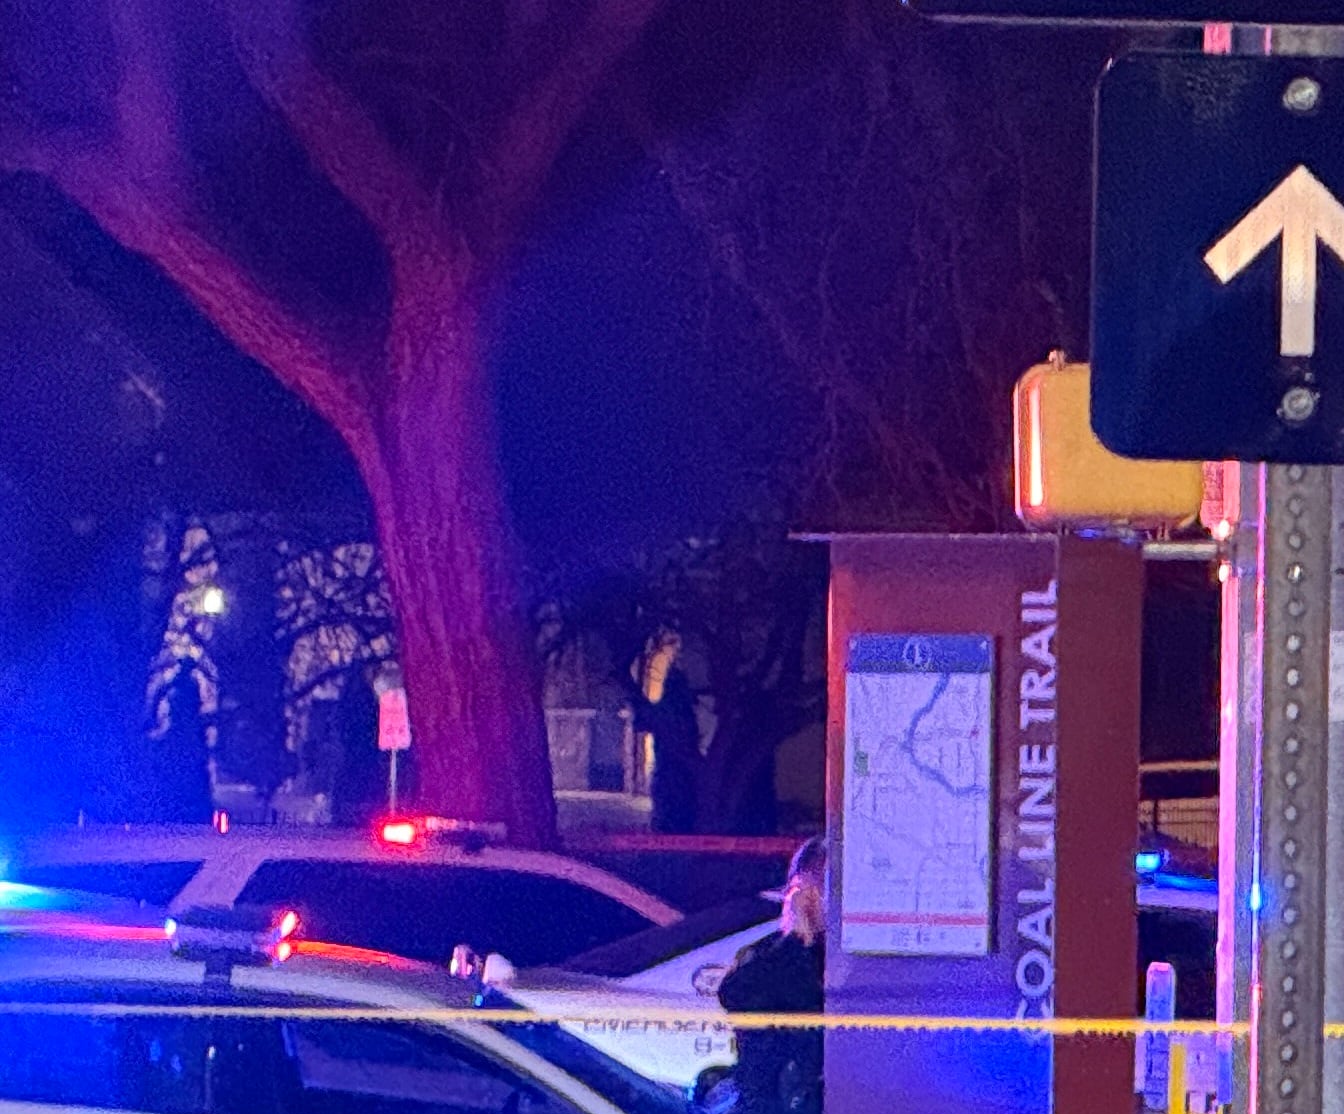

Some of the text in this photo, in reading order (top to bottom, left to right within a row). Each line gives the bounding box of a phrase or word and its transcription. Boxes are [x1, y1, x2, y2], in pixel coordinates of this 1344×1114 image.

[1016, 579, 1059, 1041] COAL LINE TRAIL
